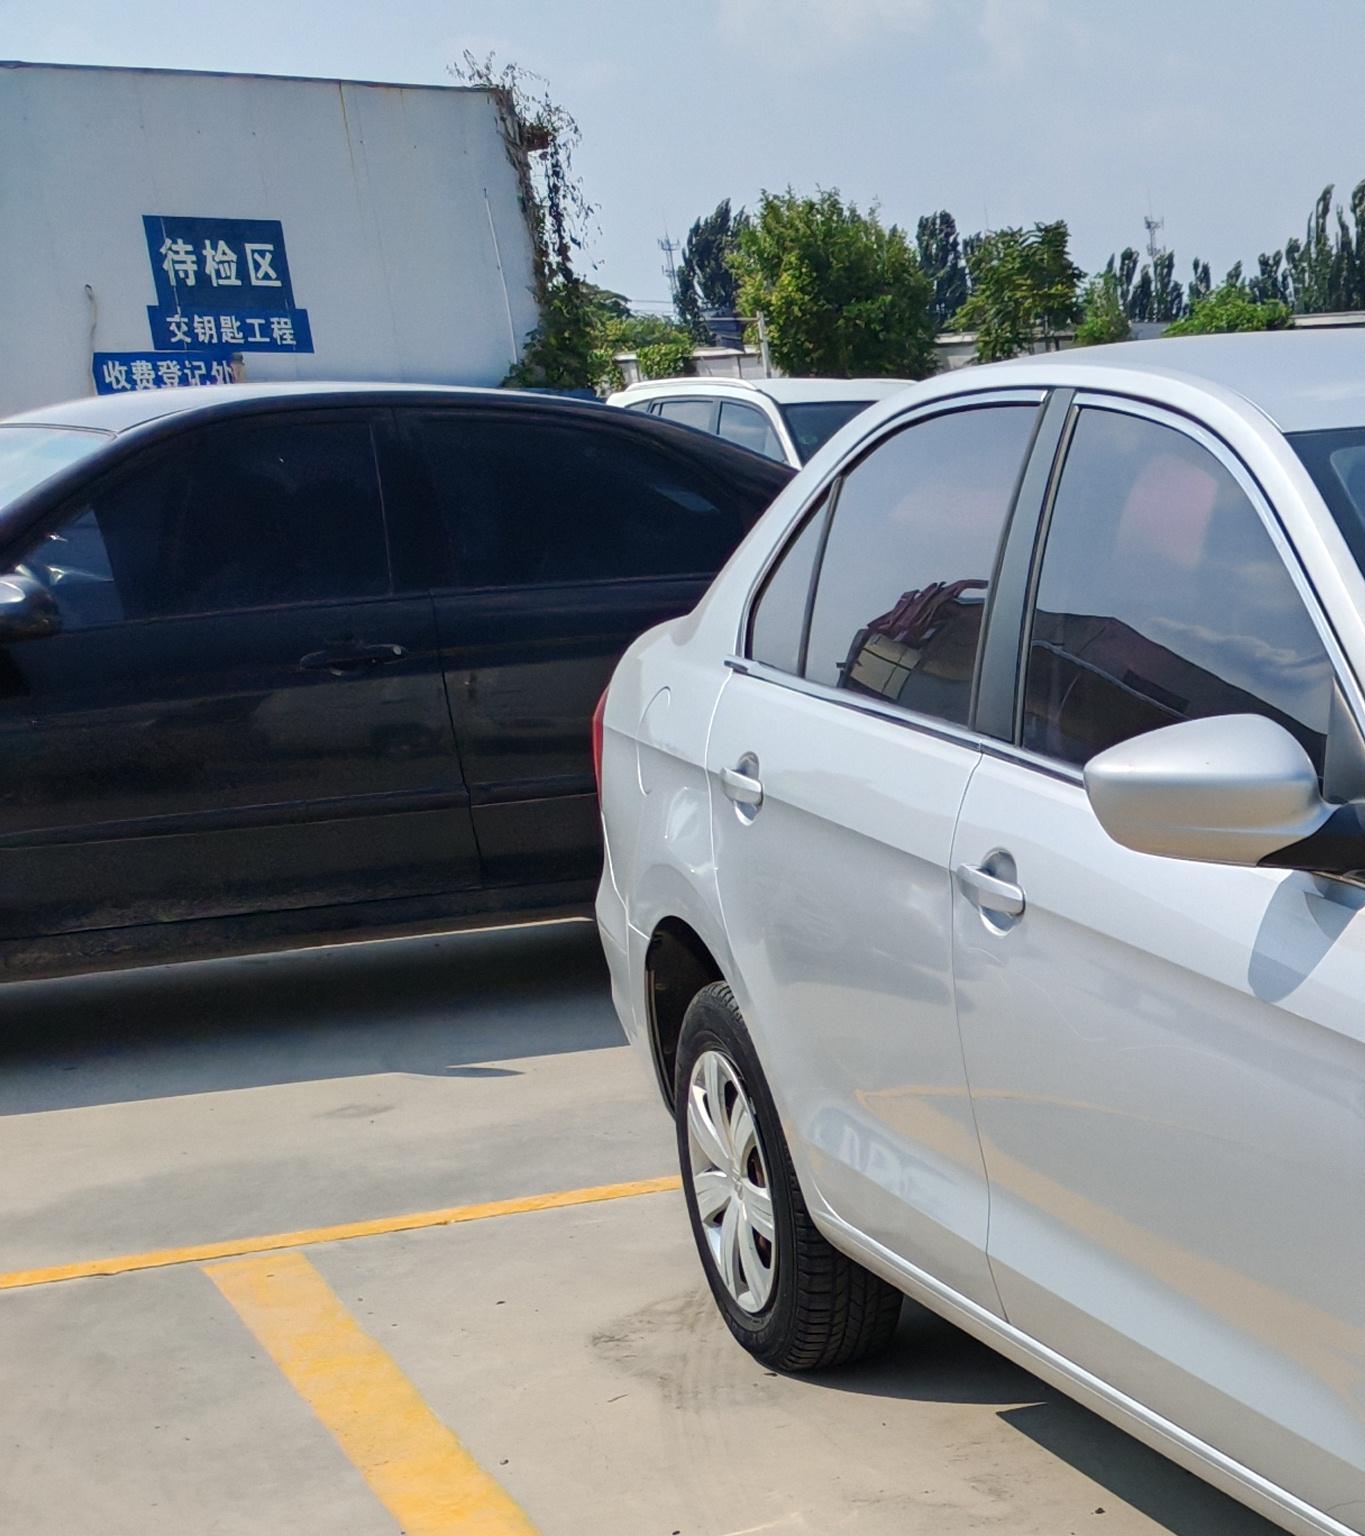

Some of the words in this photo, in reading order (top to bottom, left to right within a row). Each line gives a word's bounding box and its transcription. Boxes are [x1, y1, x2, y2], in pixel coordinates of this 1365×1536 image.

[160, 238, 282, 287] 待检区
[166, 313, 297, 346] 交钥匙工程
[103, 360, 233, 391] 收费登记处
